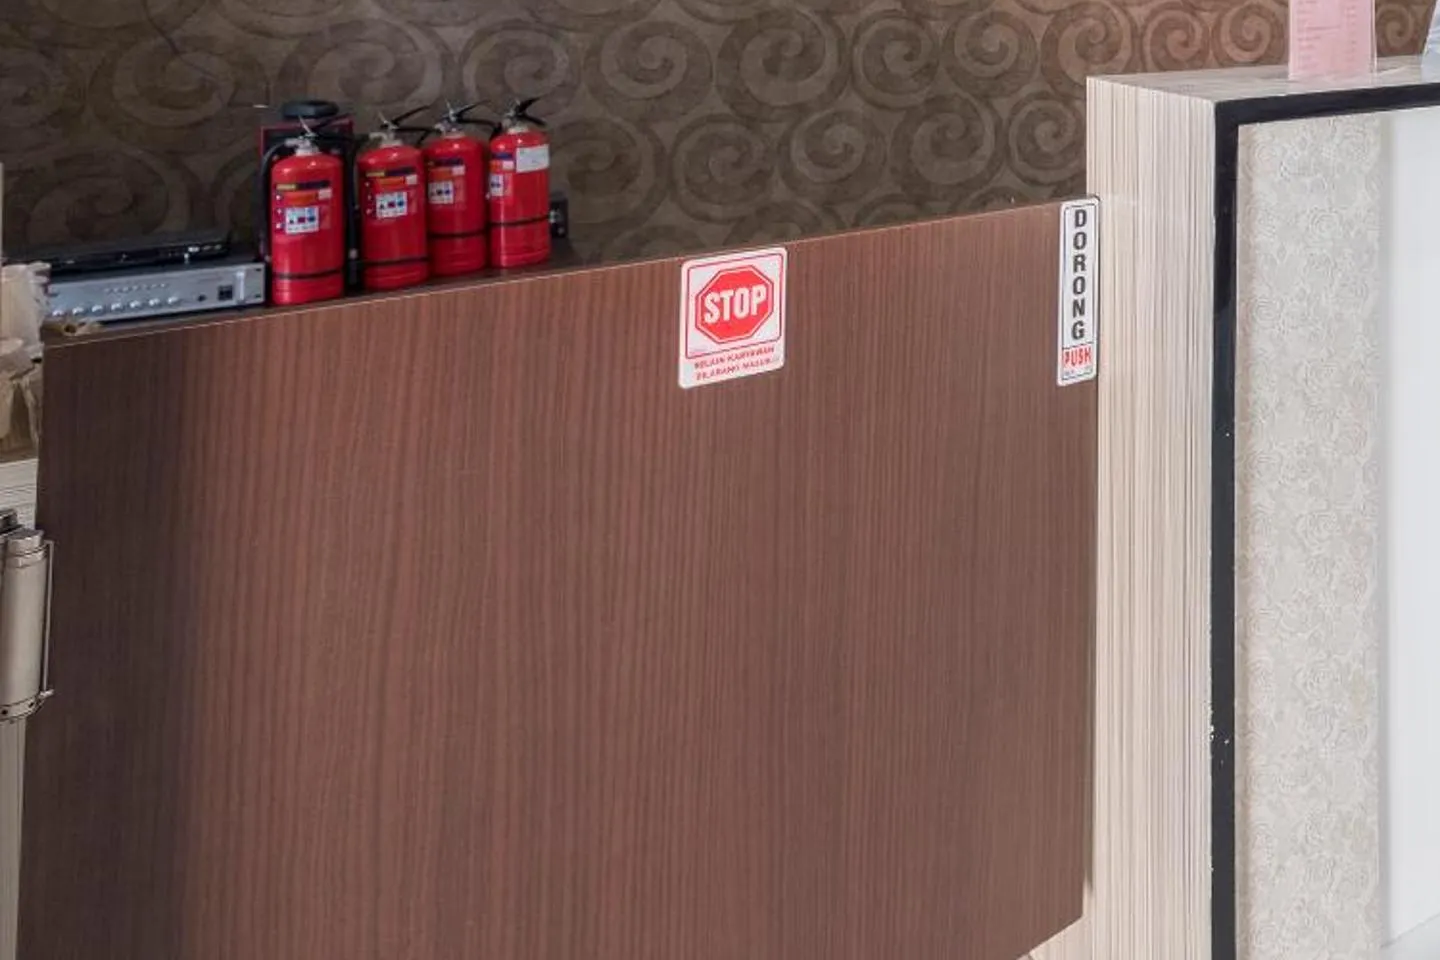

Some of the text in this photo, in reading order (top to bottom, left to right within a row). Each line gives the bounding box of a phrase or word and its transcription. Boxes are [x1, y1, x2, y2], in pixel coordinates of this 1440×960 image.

[1071, 209, 1087, 341] DORONG
[703, 284, 767, 324] STOP
[1064, 346, 1092, 367] PUSH
